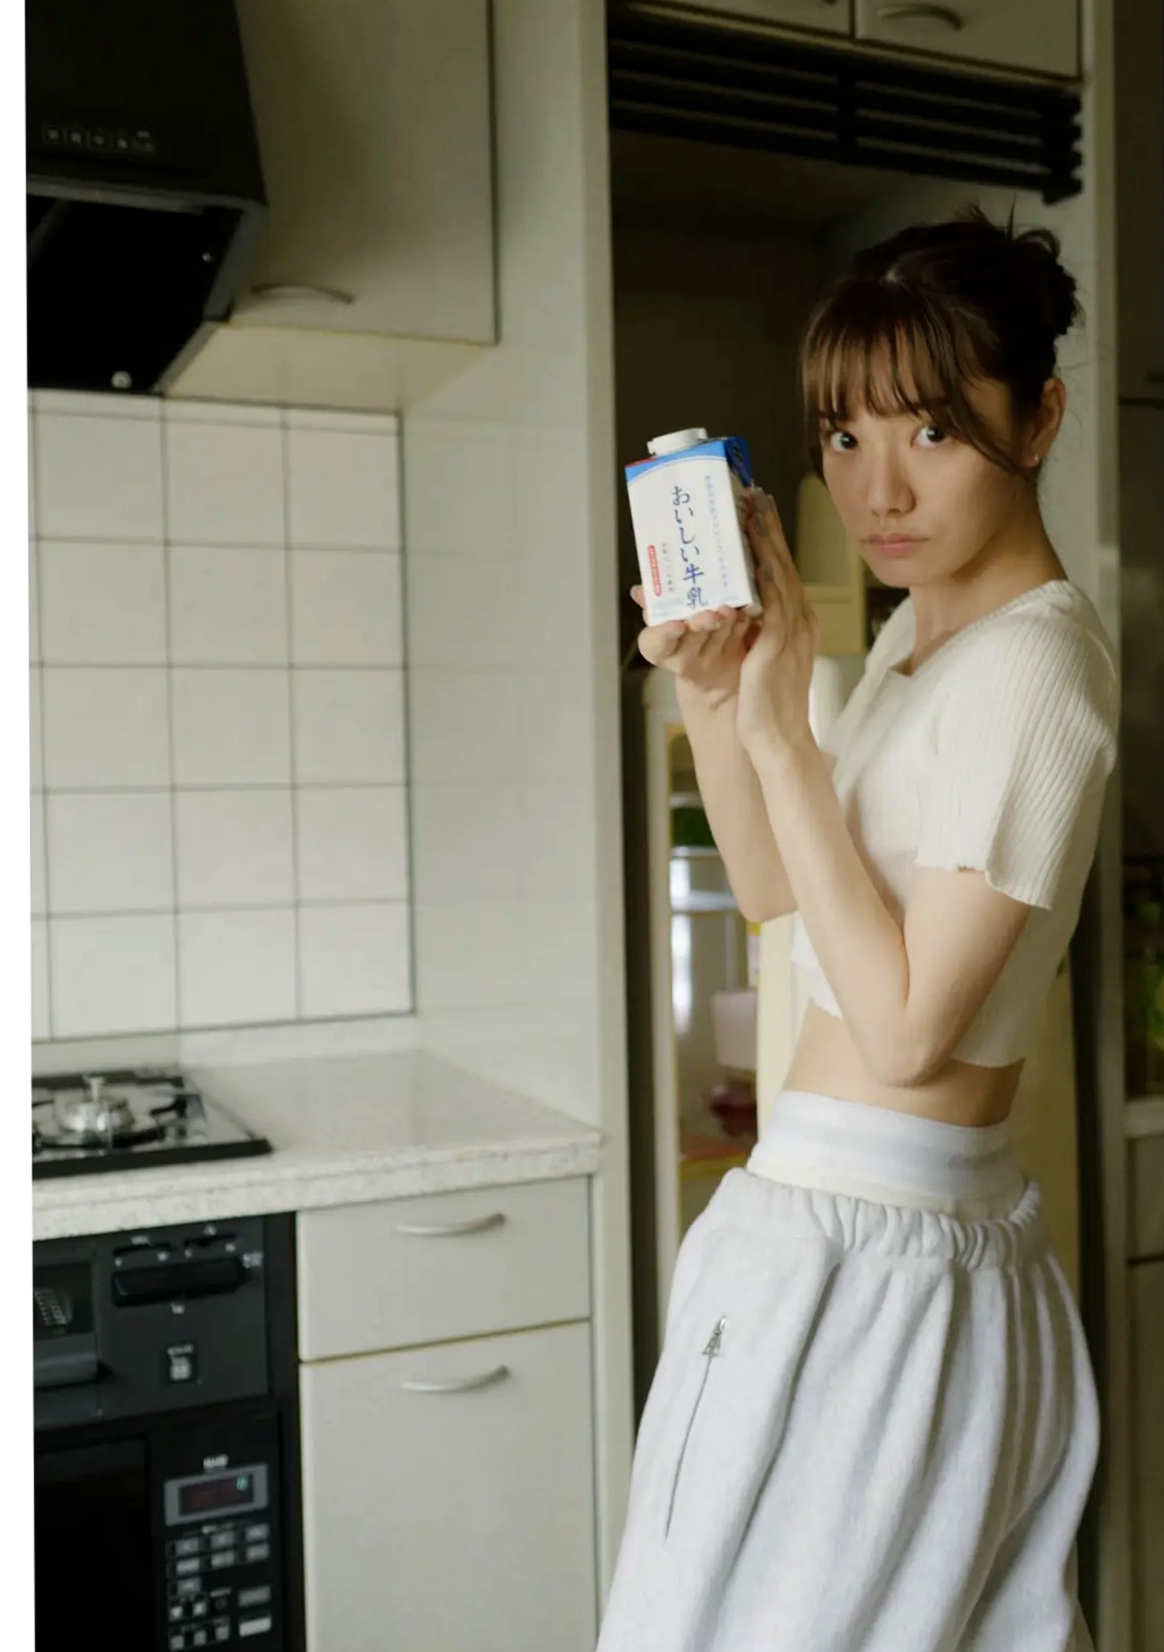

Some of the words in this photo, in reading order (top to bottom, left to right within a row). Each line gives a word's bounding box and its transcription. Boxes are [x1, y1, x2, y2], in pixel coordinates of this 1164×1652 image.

[671, 485, 708, 609] おいしい牛乳
